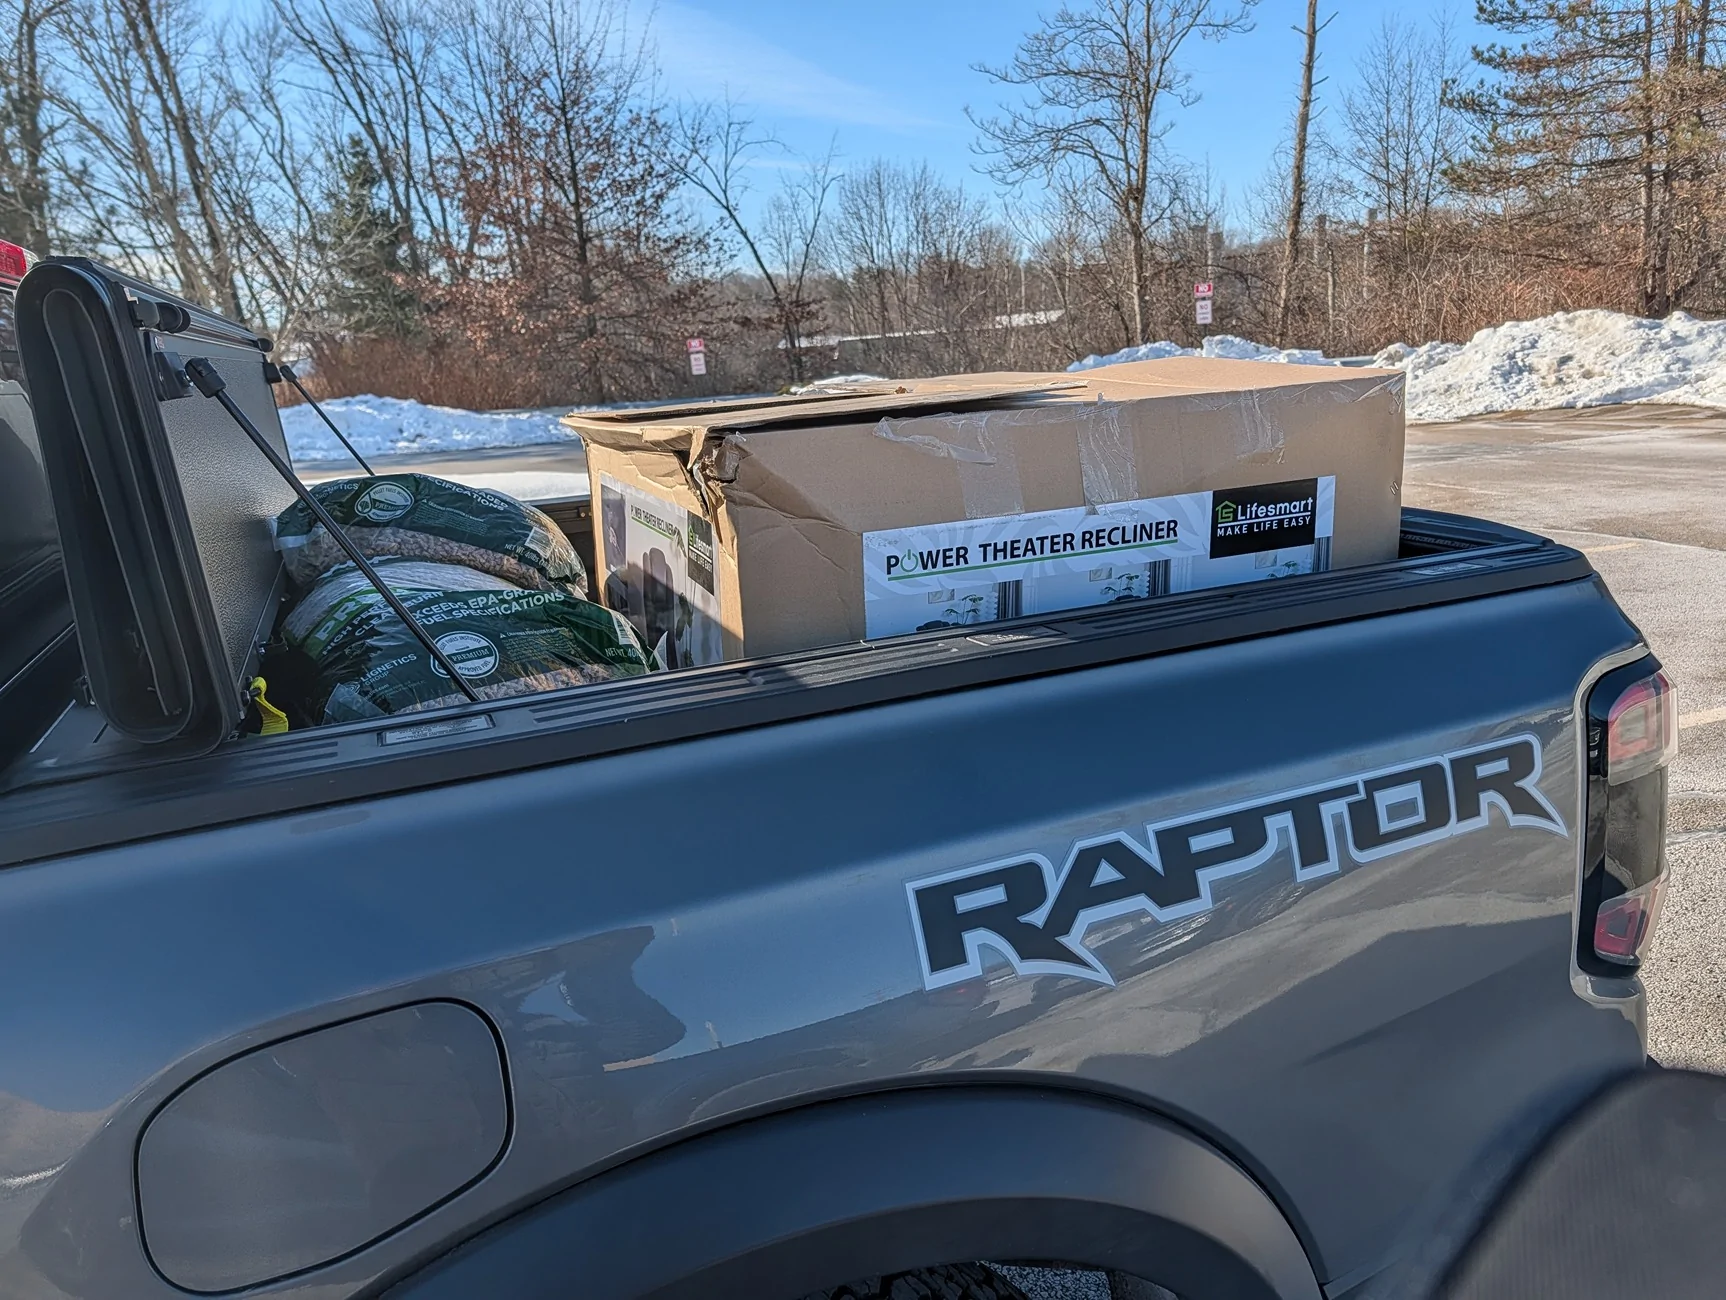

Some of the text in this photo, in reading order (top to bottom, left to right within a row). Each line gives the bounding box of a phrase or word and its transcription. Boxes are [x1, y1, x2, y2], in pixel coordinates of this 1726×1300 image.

[1237, 497, 1314, 521] Lifesmart
[1216, 515, 1311, 537] MAKE LIFE EASY
[886, 519, 1179, 575] POWER THEATER RECLINER
[412, 601, 467, 620] XCEEDS
[452, 592, 565, 619] SPECIFICATIONS
[322, 625, 353, 656] HIGH
[360, 653, 417, 682] LIGNETICS
[451, 648, 490, 662] PREMIUM
[905, 733, 1568, 990] RAPTOR
